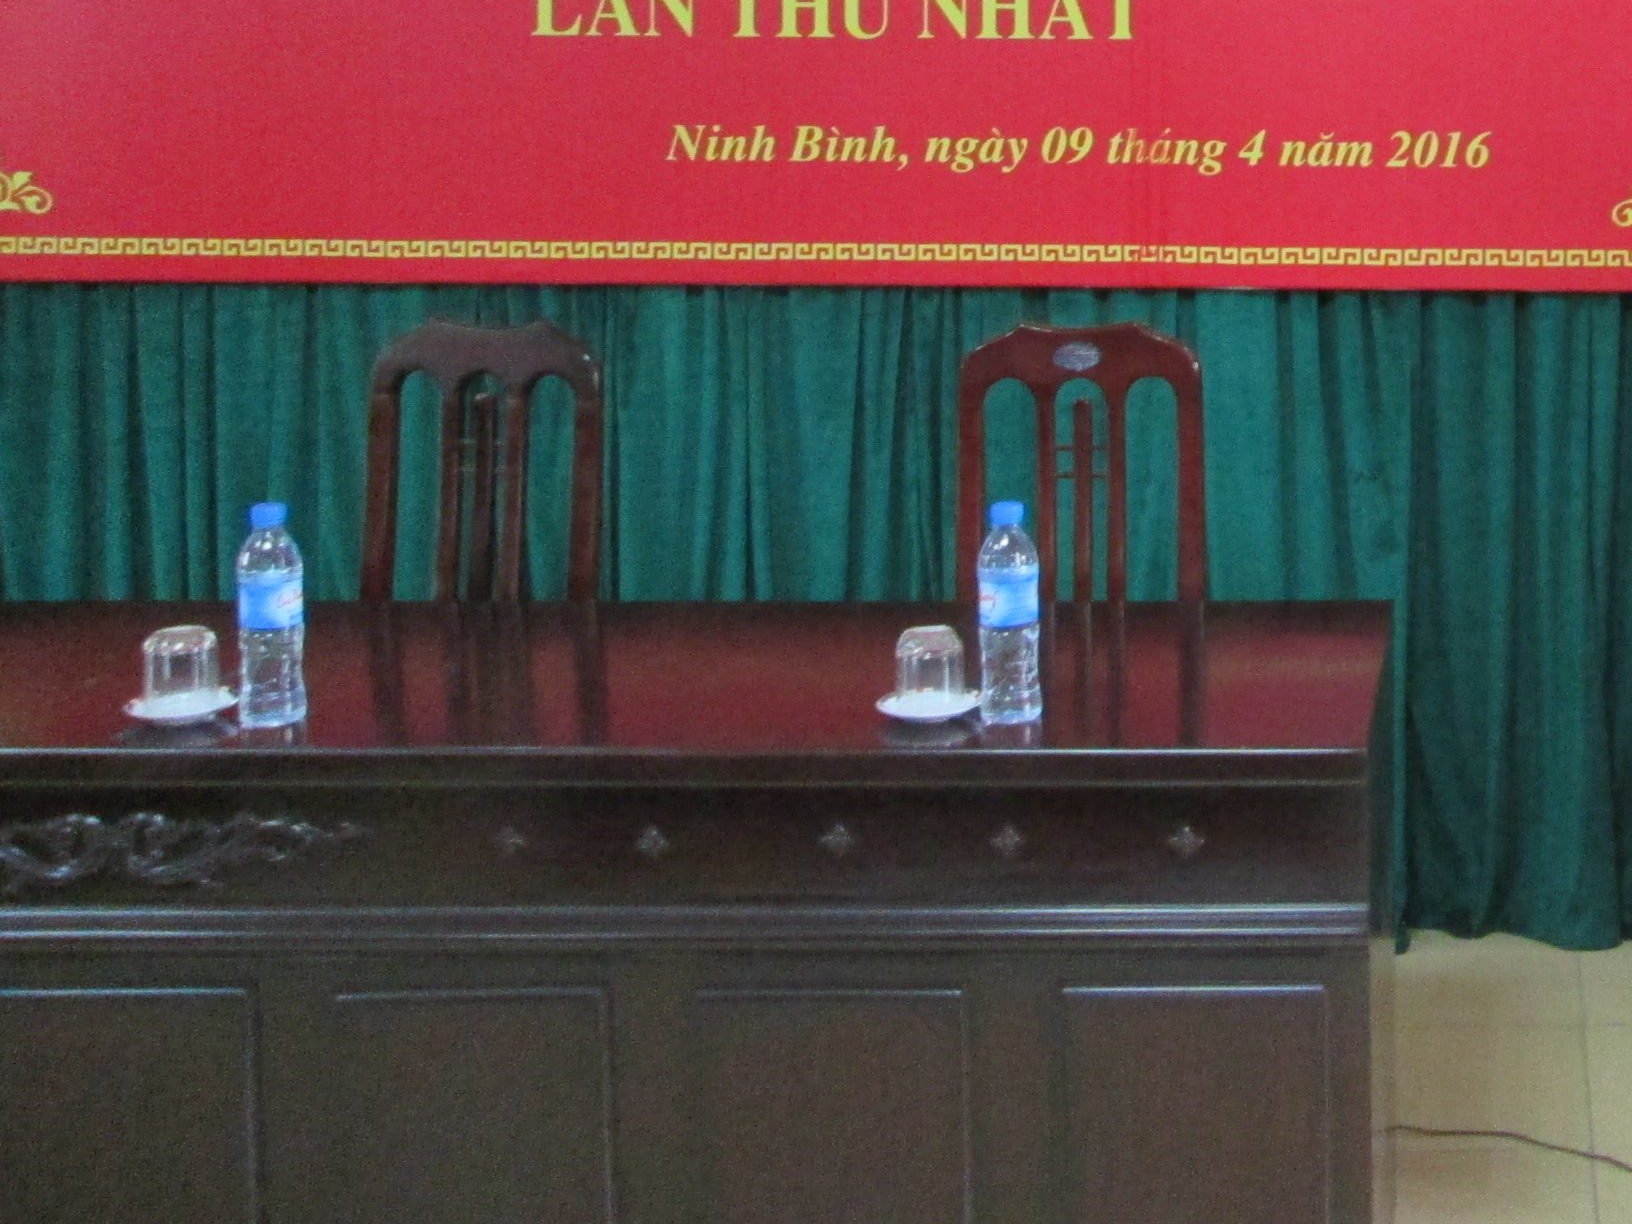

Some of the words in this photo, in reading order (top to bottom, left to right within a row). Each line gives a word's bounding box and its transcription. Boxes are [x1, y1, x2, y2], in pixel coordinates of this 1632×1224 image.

[666, 122, 778, 164] Ninh
[789, 122, 911, 172] Bình,
[923, 129, 1031, 175] ngày
[1040, 127, 1097, 165] 09
[1106, 127, 1228, 177] tháng
[1237, 129, 1268, 167] 4
[1277, 130, 1375, 168] năm
[1384, 128, 1492, 170] 2016
